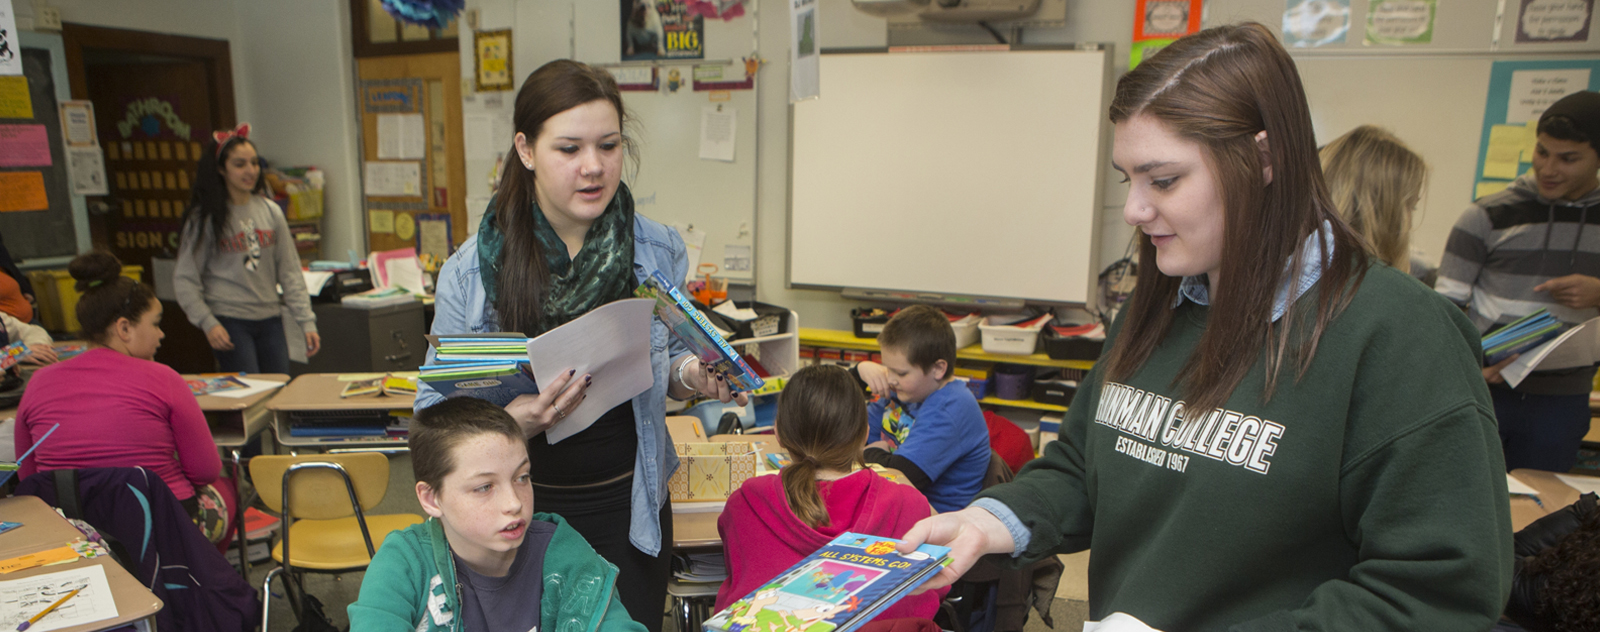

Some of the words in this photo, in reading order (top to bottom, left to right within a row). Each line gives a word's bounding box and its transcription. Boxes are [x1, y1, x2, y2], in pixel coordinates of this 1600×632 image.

[667, 30, 699, 50] BIG
[117, 97, 191, 141] BATHROOM
[116, 231, 163, 249] SIGN
[692, 309, 718, 339] SYSTEMS
[718, 336, 728, 349] ALL
[1095, 381, 1172, 443] HINMAN
[1160, 400, 1286, 475] COLLEGE
[1115, 435, 1167, 467] ESTABLISHED
[1166, 452, 1190, 473] 1967
[819, 551, 840, 559] ALL
[839, 553, 889, 567] SYSTEMS
[888, 561, 912, 570] GO!
